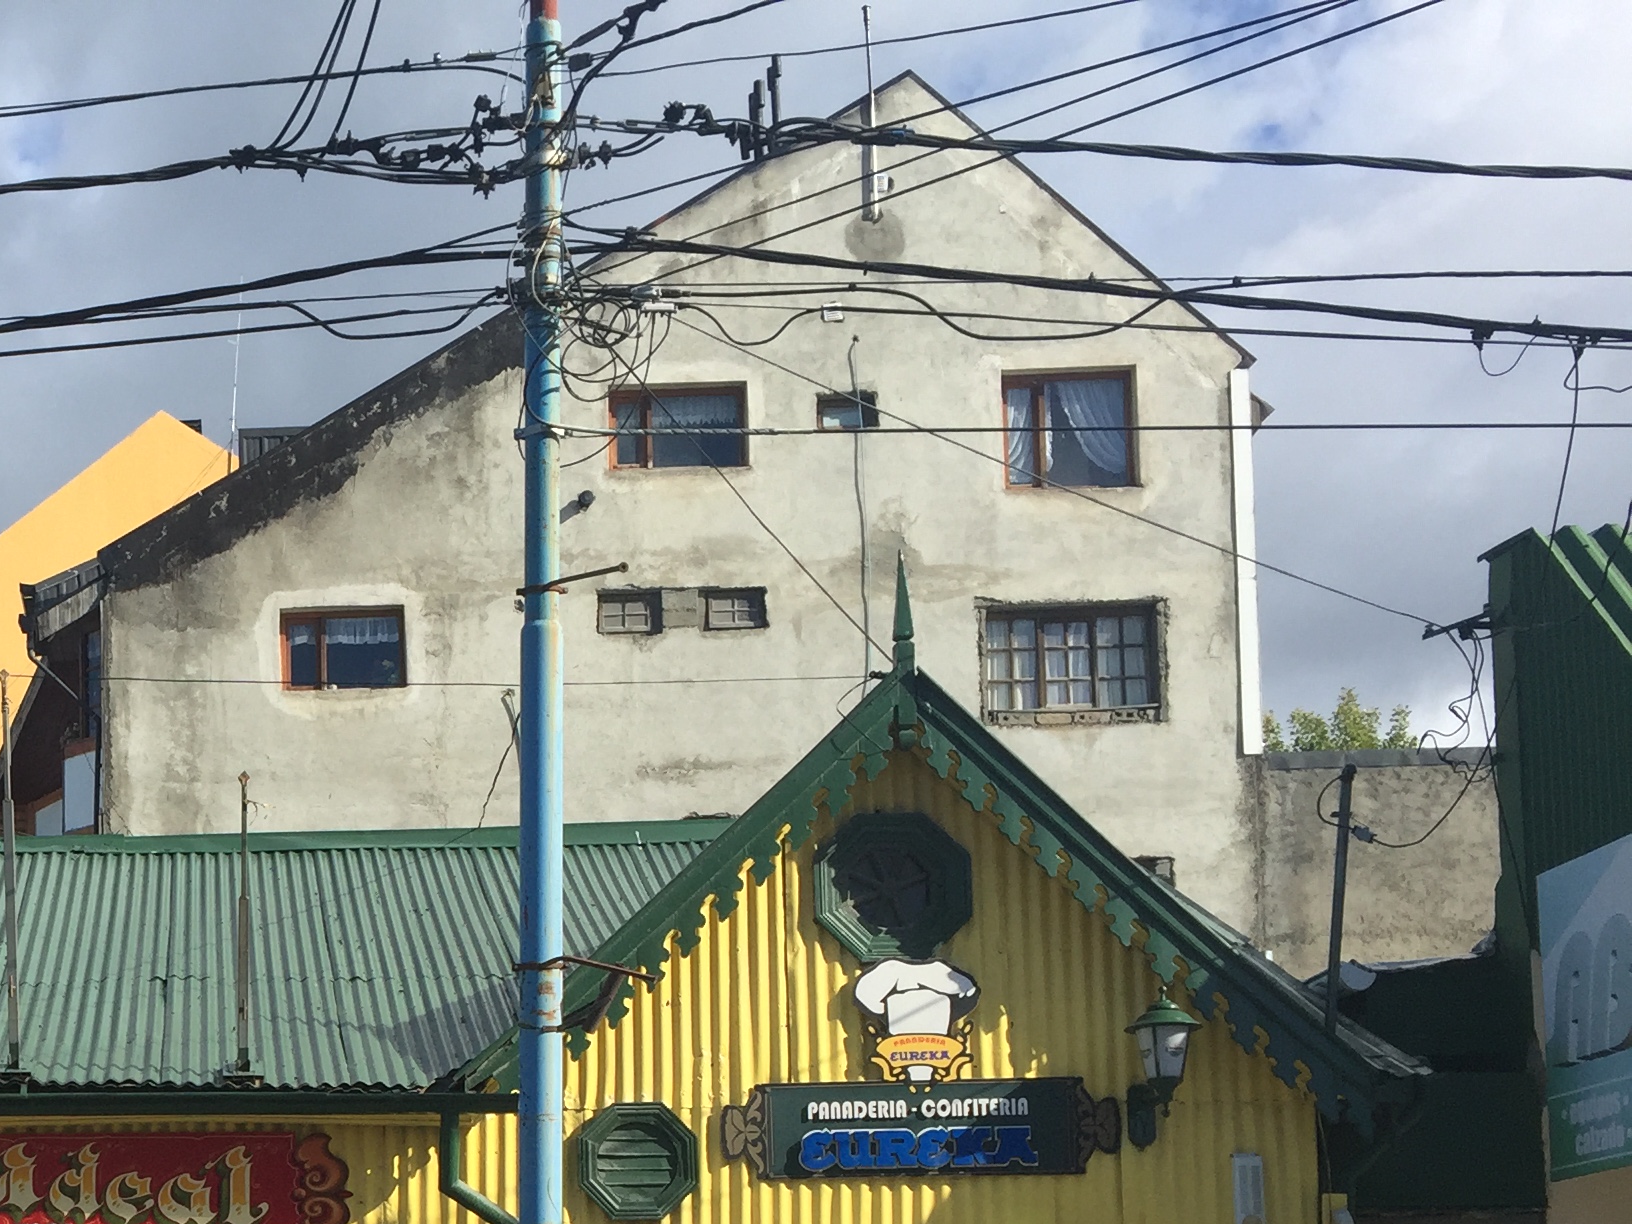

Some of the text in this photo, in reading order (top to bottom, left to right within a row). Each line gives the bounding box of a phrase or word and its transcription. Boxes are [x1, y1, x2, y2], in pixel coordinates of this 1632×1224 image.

[893, 1036, 946, 1047] PANADERIA
[890, 1050, 951, 1062] EUREKA
[807, 1100, 908, 1120] PANADERIA
[921, 1098, 1029, 1118] CONFITERIA
[799, 1125, 1039, 1172] EUREKA
